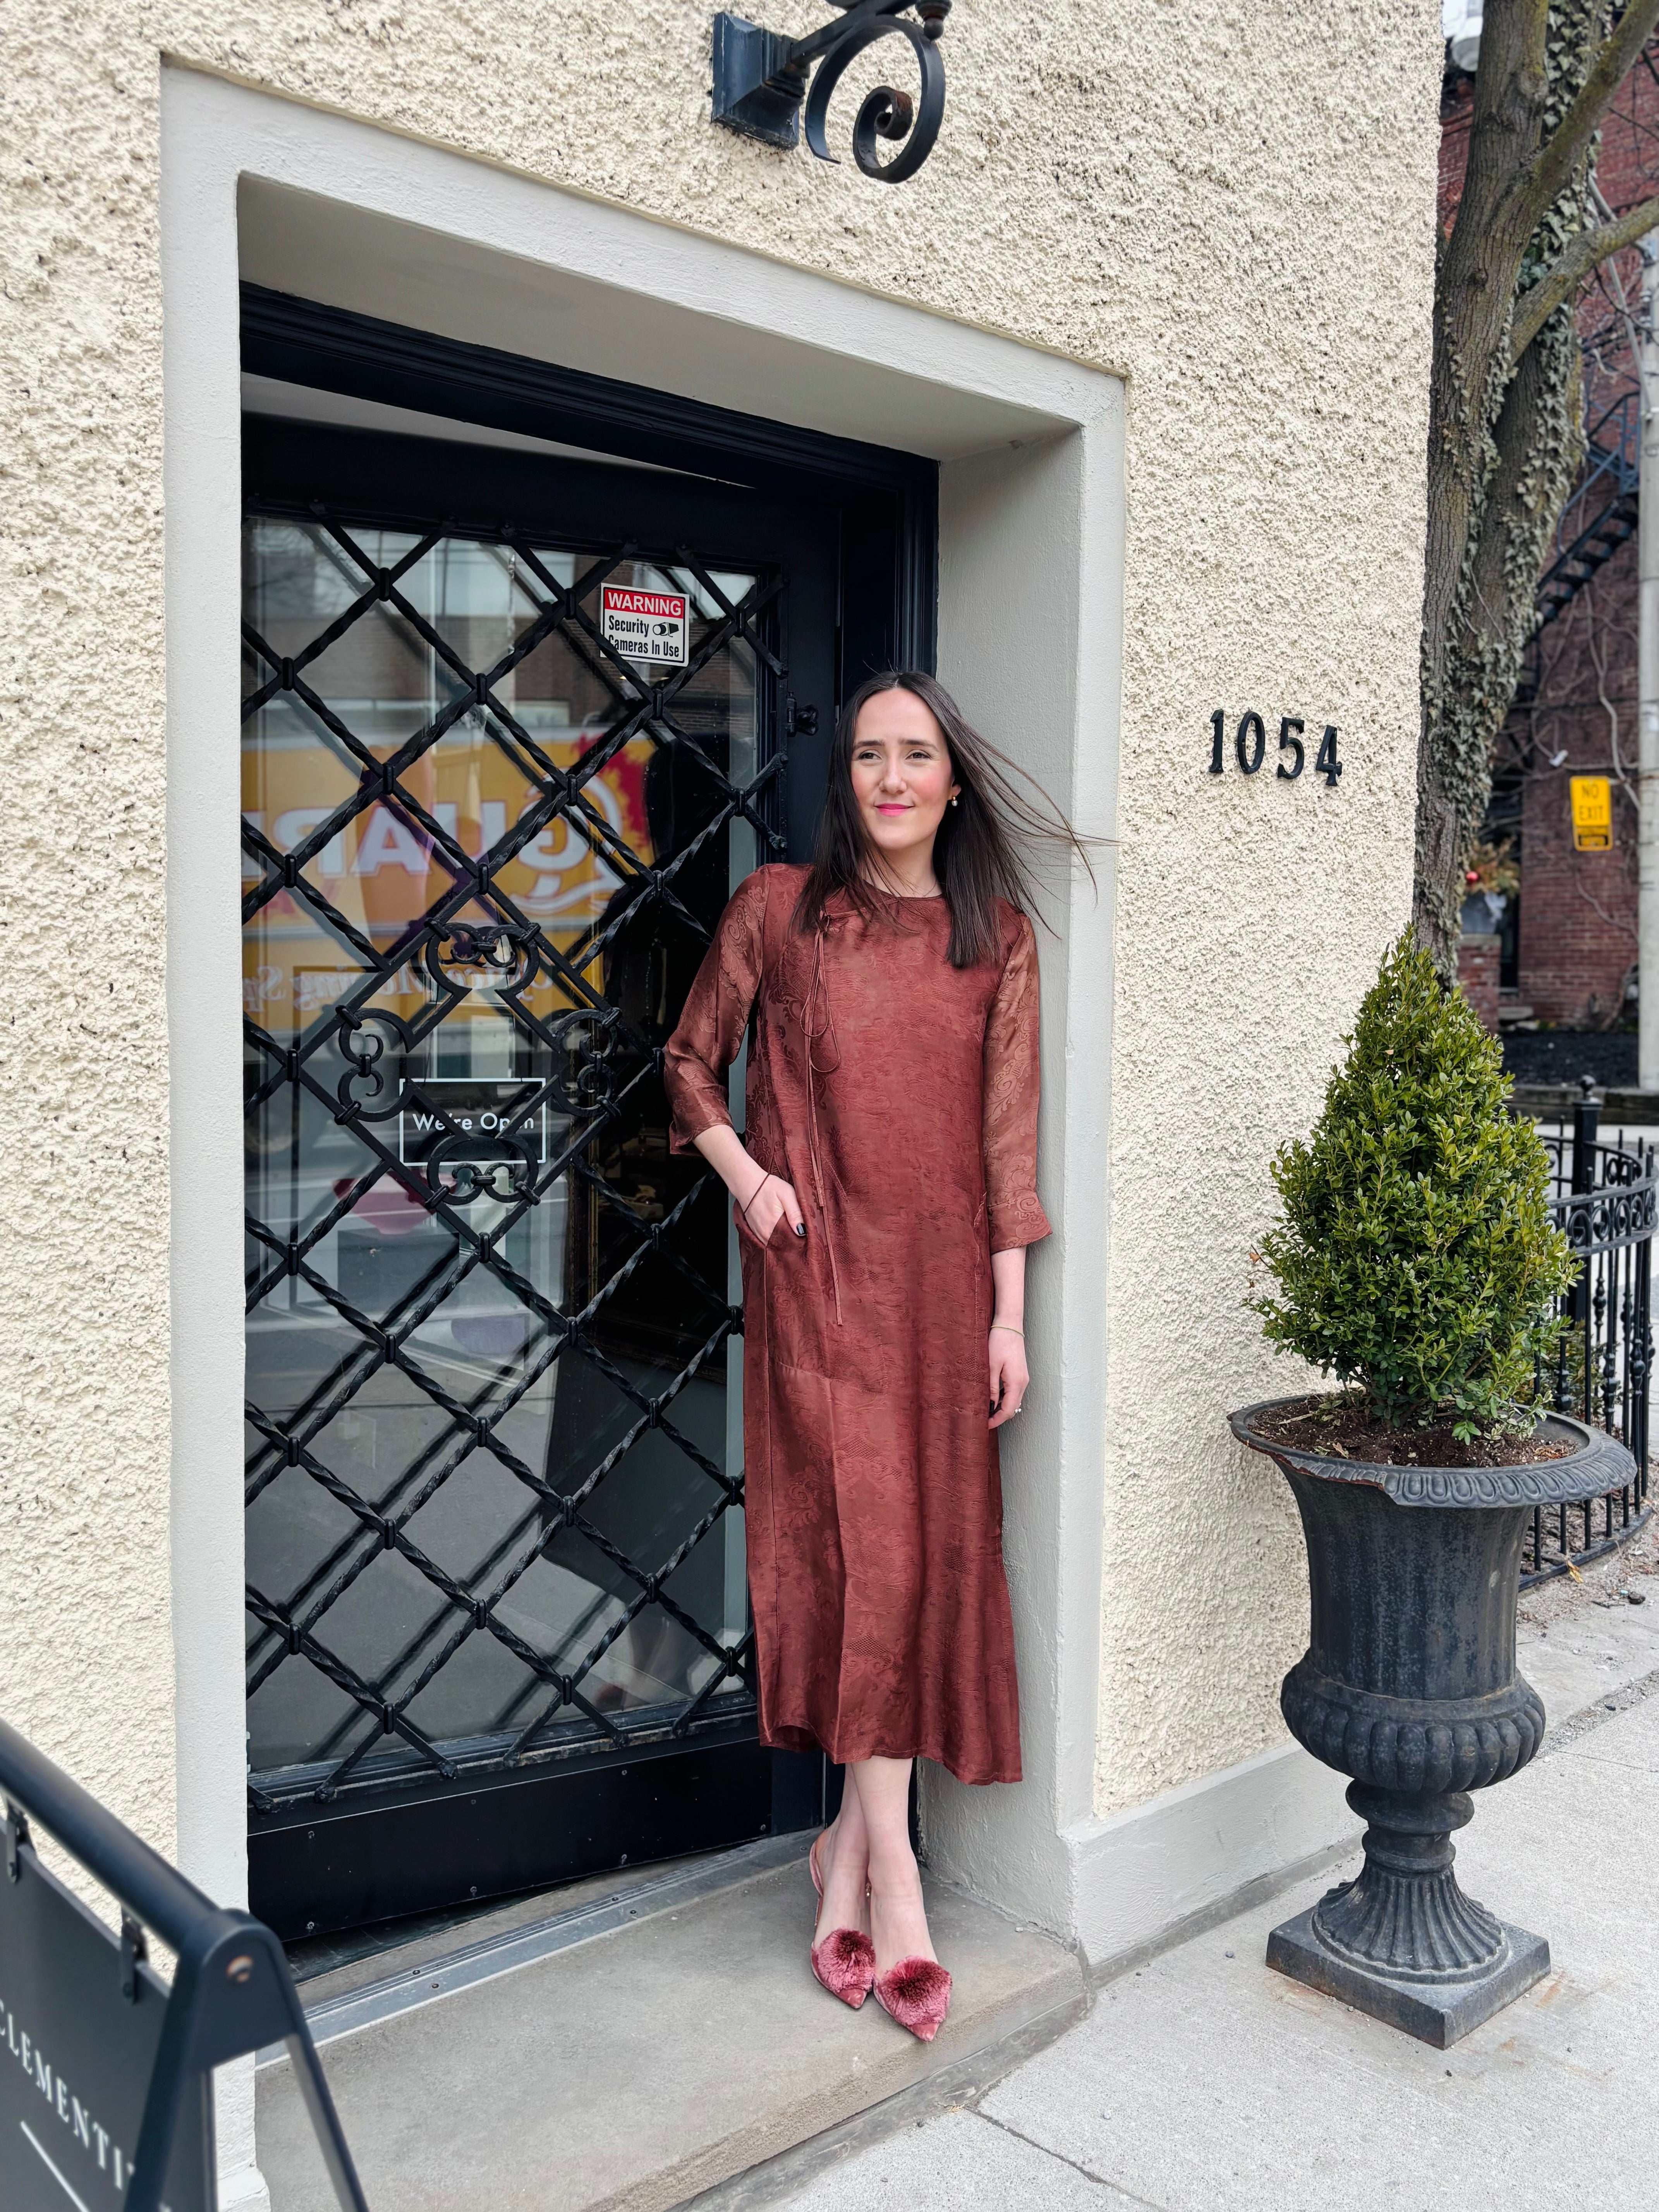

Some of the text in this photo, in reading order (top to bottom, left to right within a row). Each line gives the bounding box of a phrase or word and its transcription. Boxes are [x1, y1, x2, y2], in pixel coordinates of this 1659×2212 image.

[608, 592, 681, 616] WARNING
[608, 615, 649, 637] Security
[608, 635, 679, 657] Cameras In Use
[1209, 709, 1343, 787] 1054
[1581, 783, 1599, 799] NO
[1578, 804, 1604, 821] EXIT
[480, 1113, 534, 1131] Opn
[0, 1997, 135, 2191] LEMENTI
